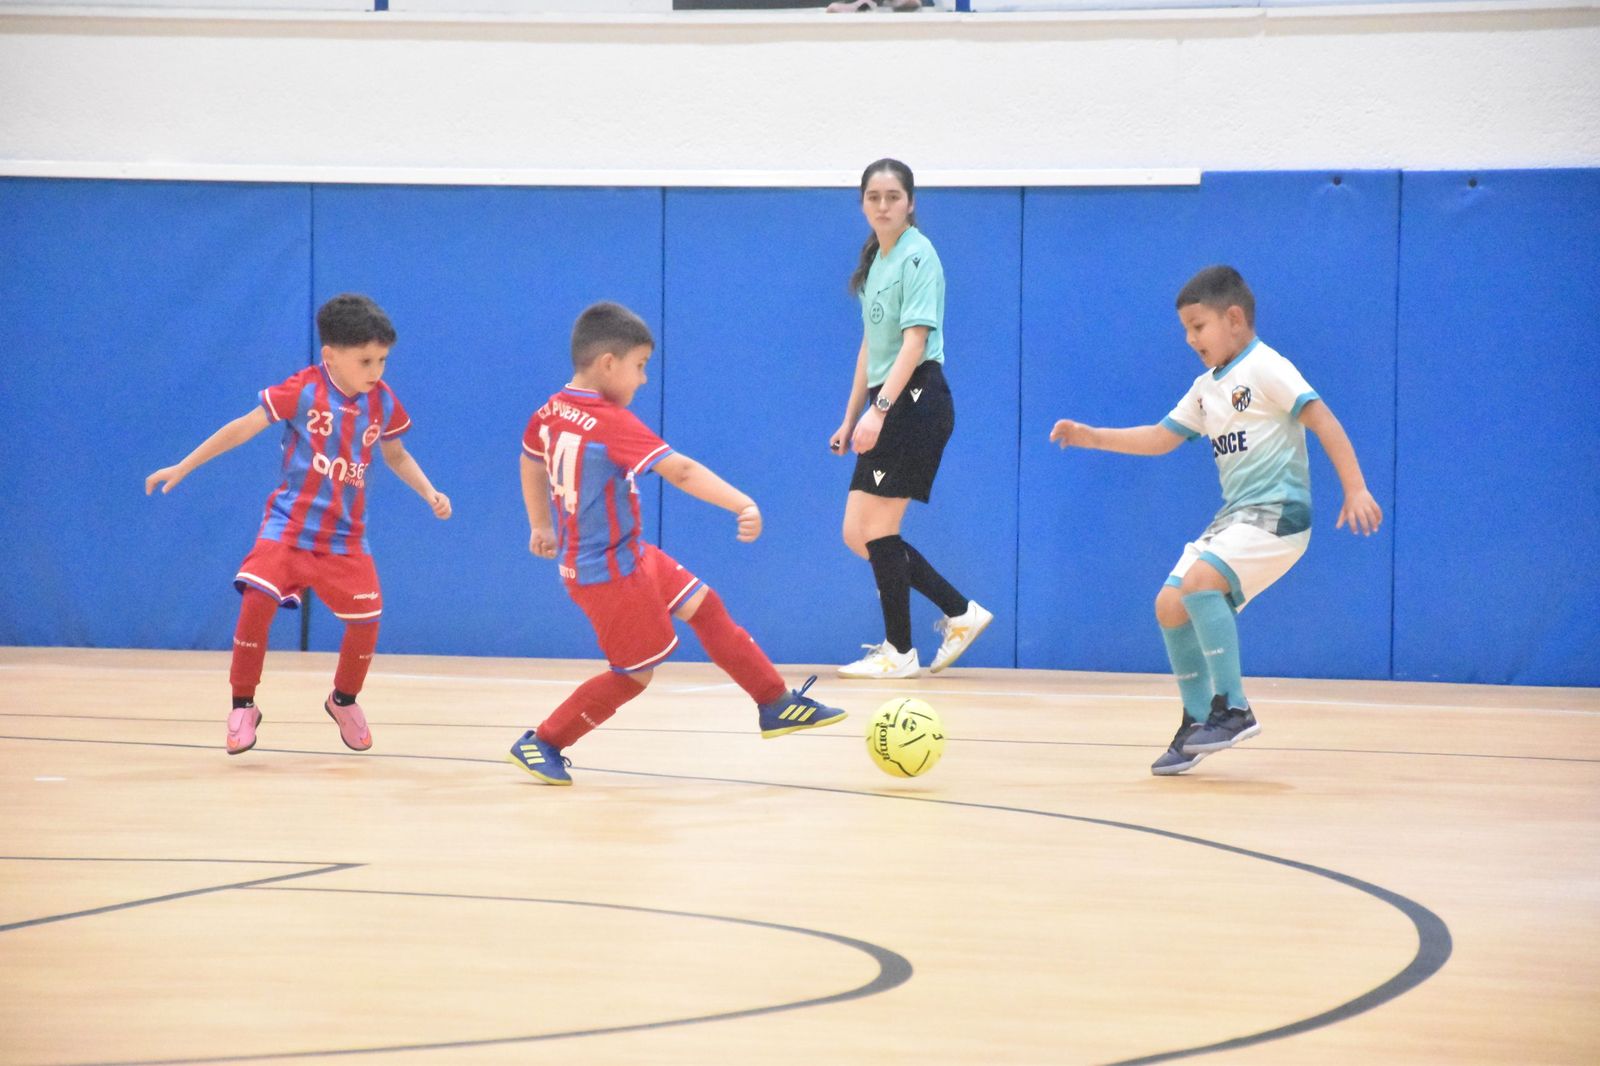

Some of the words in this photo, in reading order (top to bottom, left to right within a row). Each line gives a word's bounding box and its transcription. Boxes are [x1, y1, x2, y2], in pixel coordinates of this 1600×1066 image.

[307, 409, 333, 436] 23
[552, 400, 598, 431] PUERTO
[539, 424, 582, 514] 14
